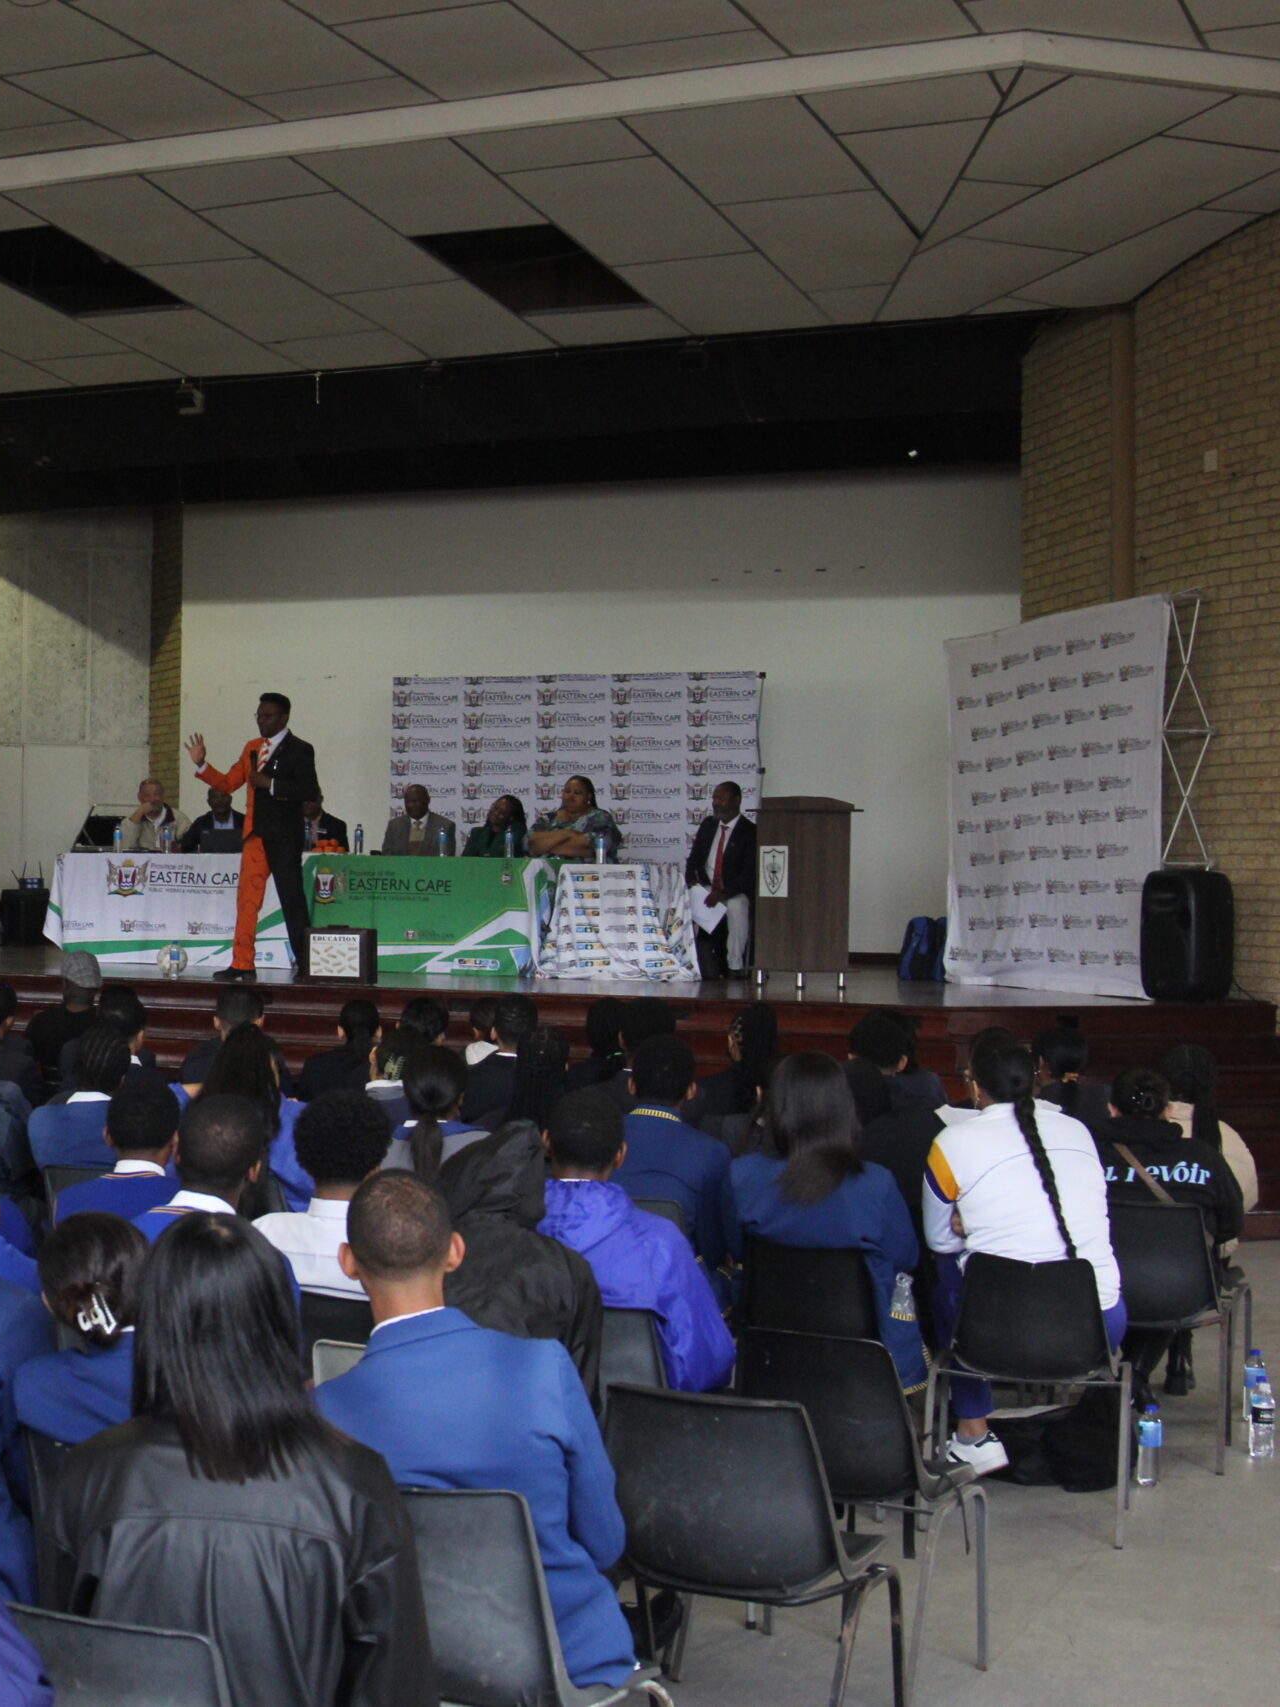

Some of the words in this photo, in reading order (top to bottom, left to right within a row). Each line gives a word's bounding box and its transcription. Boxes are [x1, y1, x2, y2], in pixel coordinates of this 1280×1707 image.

[149, 871, 207, 885] EASTERN
[211, 872, 240, 885] CAP
[349, 878, 410, 891] EASTERN
[415, 879, 452, 892] CAPE
[312, 935, 357, 943] EDUCATION
